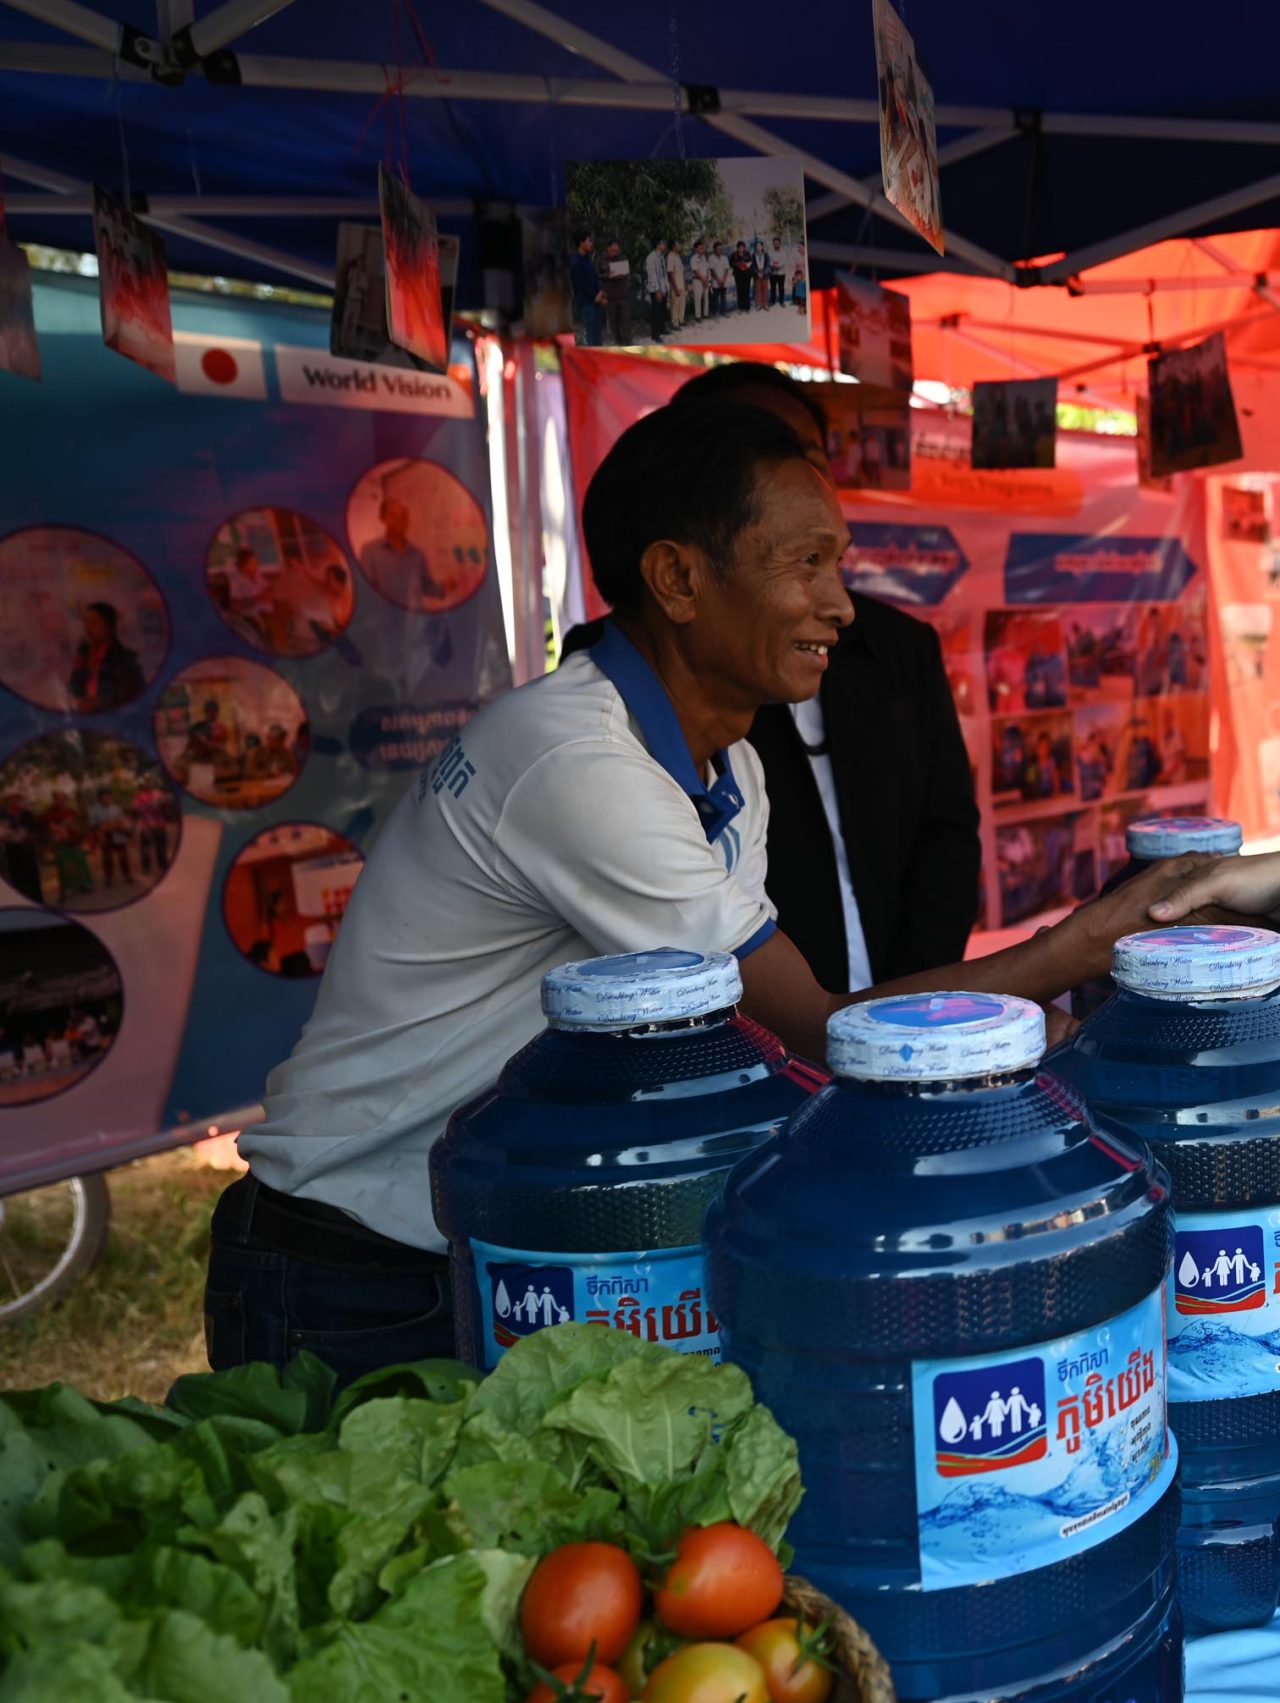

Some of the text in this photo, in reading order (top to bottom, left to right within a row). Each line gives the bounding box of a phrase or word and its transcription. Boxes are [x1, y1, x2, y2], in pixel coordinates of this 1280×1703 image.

[303, 365, 452, 398] World Vision
[596, 988, 661, 1003] Drinking Water
[585, 1274, 649, 1296] ទឹកពិសា
[1056, 1348, 1109, 1382] ទឹកពិសា
[1056, 1346, 1155, 1455] ភូមិយើង
